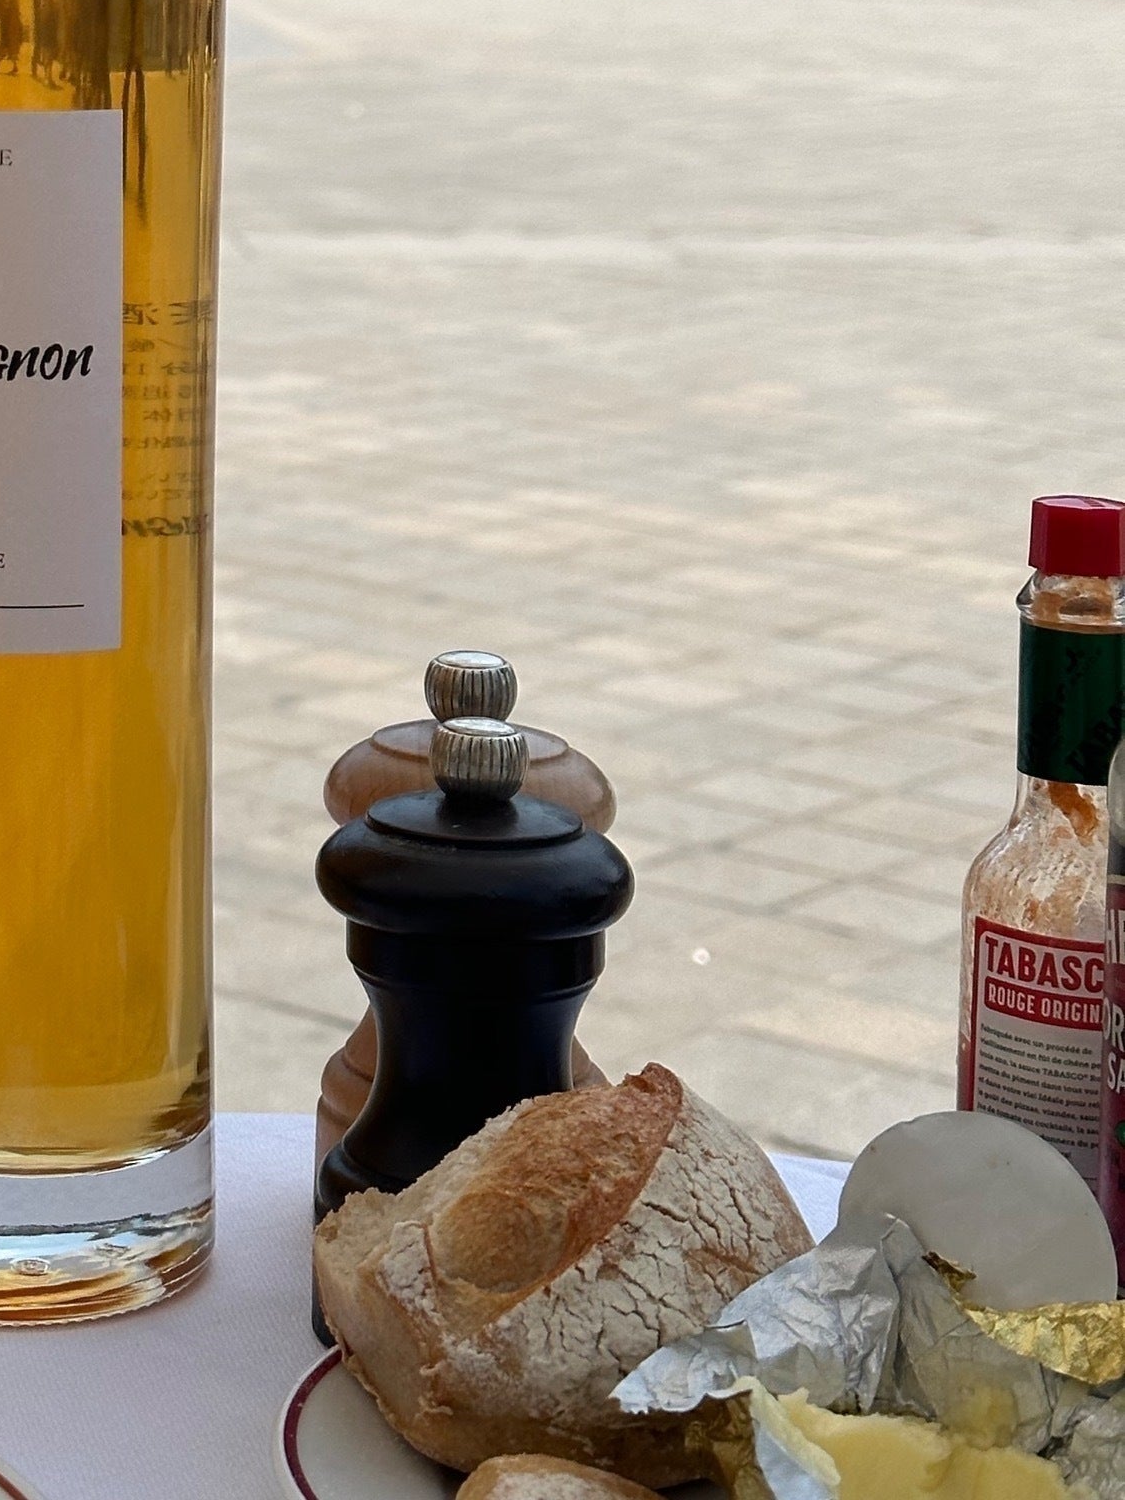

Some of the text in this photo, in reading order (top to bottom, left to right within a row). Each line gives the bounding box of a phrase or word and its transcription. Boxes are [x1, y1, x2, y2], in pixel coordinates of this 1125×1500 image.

[985, 935, 1104, 993] TABASC
[988, 983, 1102, 1024] ROUGE ORIGIN
[1103, 997, 1125, 1051] OR
